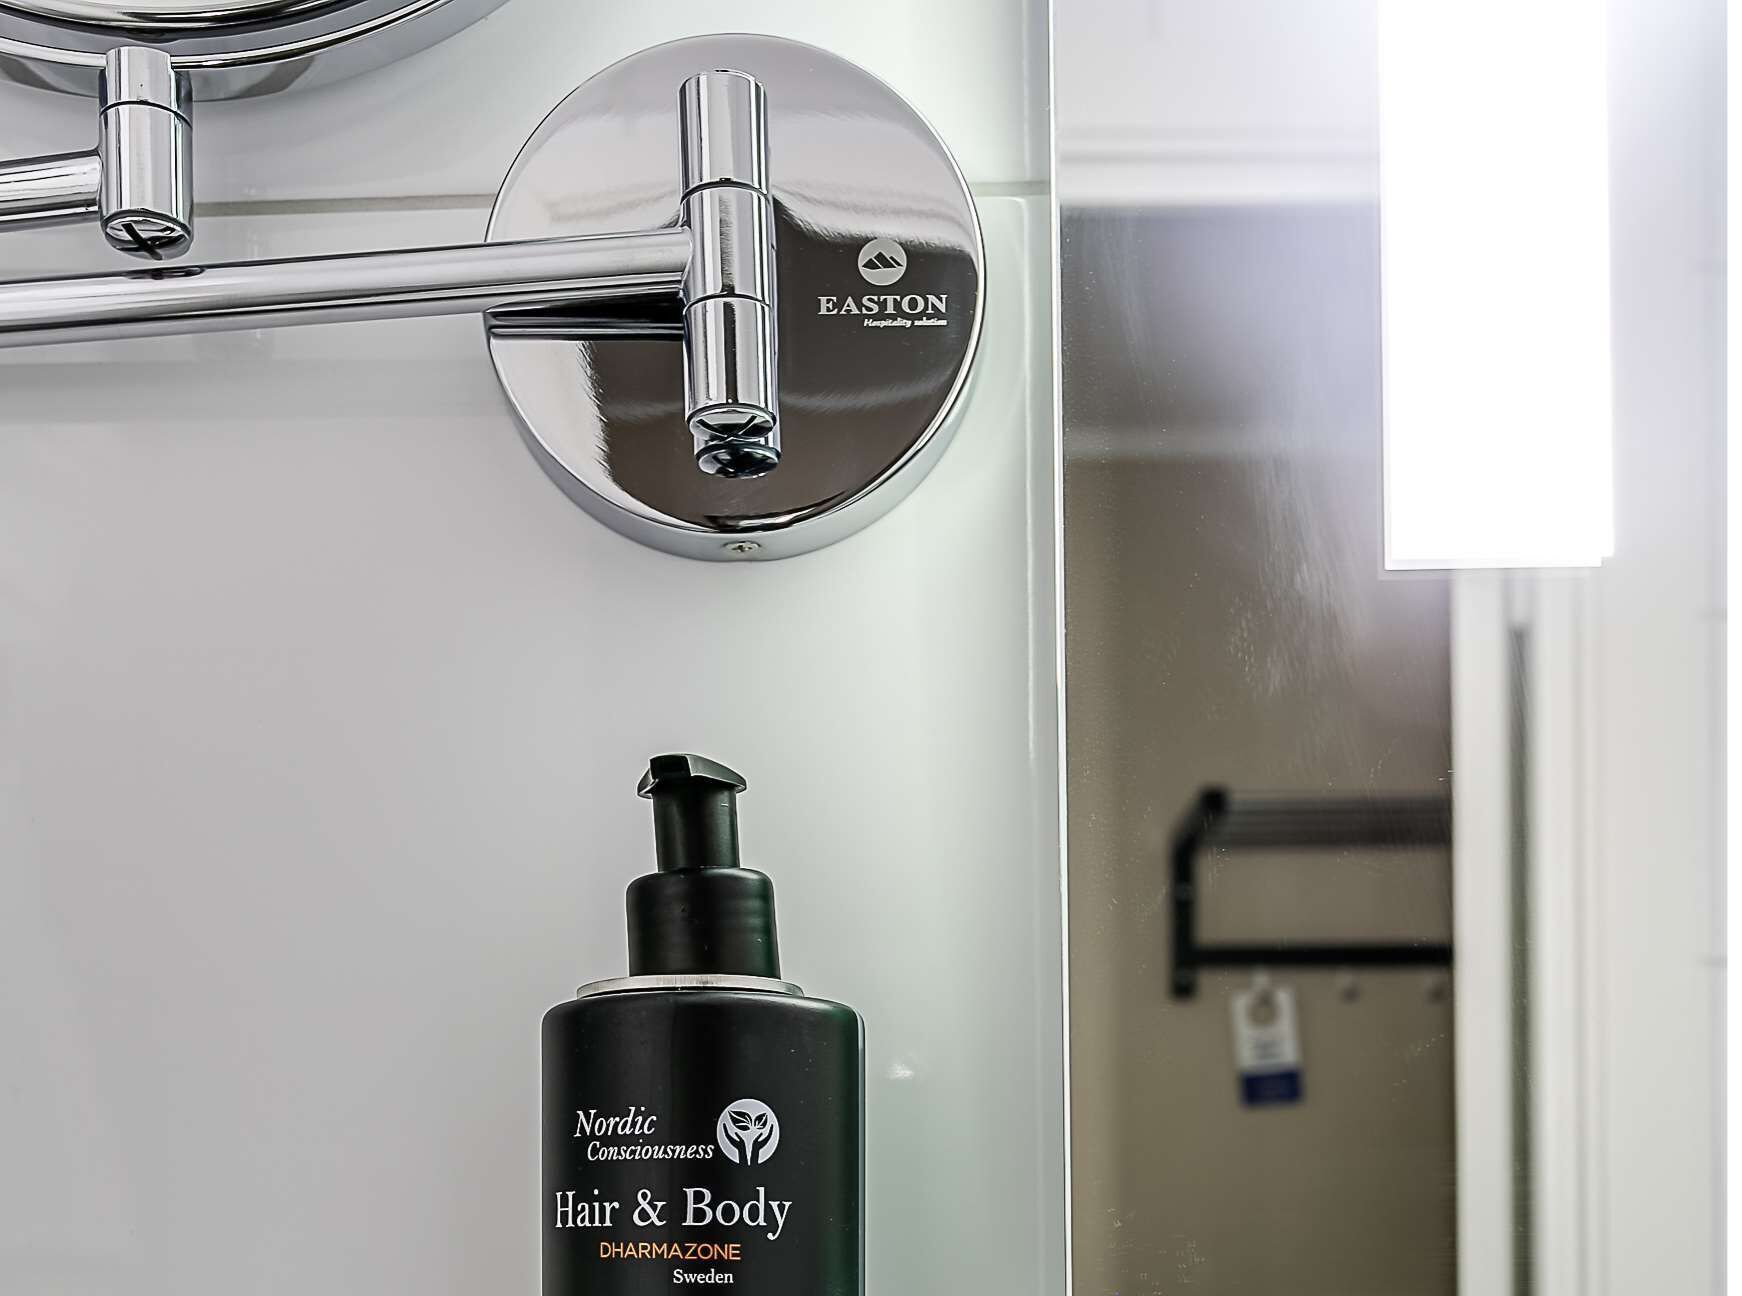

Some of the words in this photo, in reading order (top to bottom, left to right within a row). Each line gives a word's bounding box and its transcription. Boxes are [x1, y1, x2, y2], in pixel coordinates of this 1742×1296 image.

[817, 295, 948, 314] EASTON
[574, 1106, 657, 1137] Nordic
[587, 1139, 714, 1161] Consciousness
[555, 1189, 620, 1228] Hair
[632, 1189, 666, 1227] &
[682, 1187, 793, 1240] Body
[600, 1242, 741, 1260] DHARMAZONE
[673, 1269, 734, 1284] Sweden
